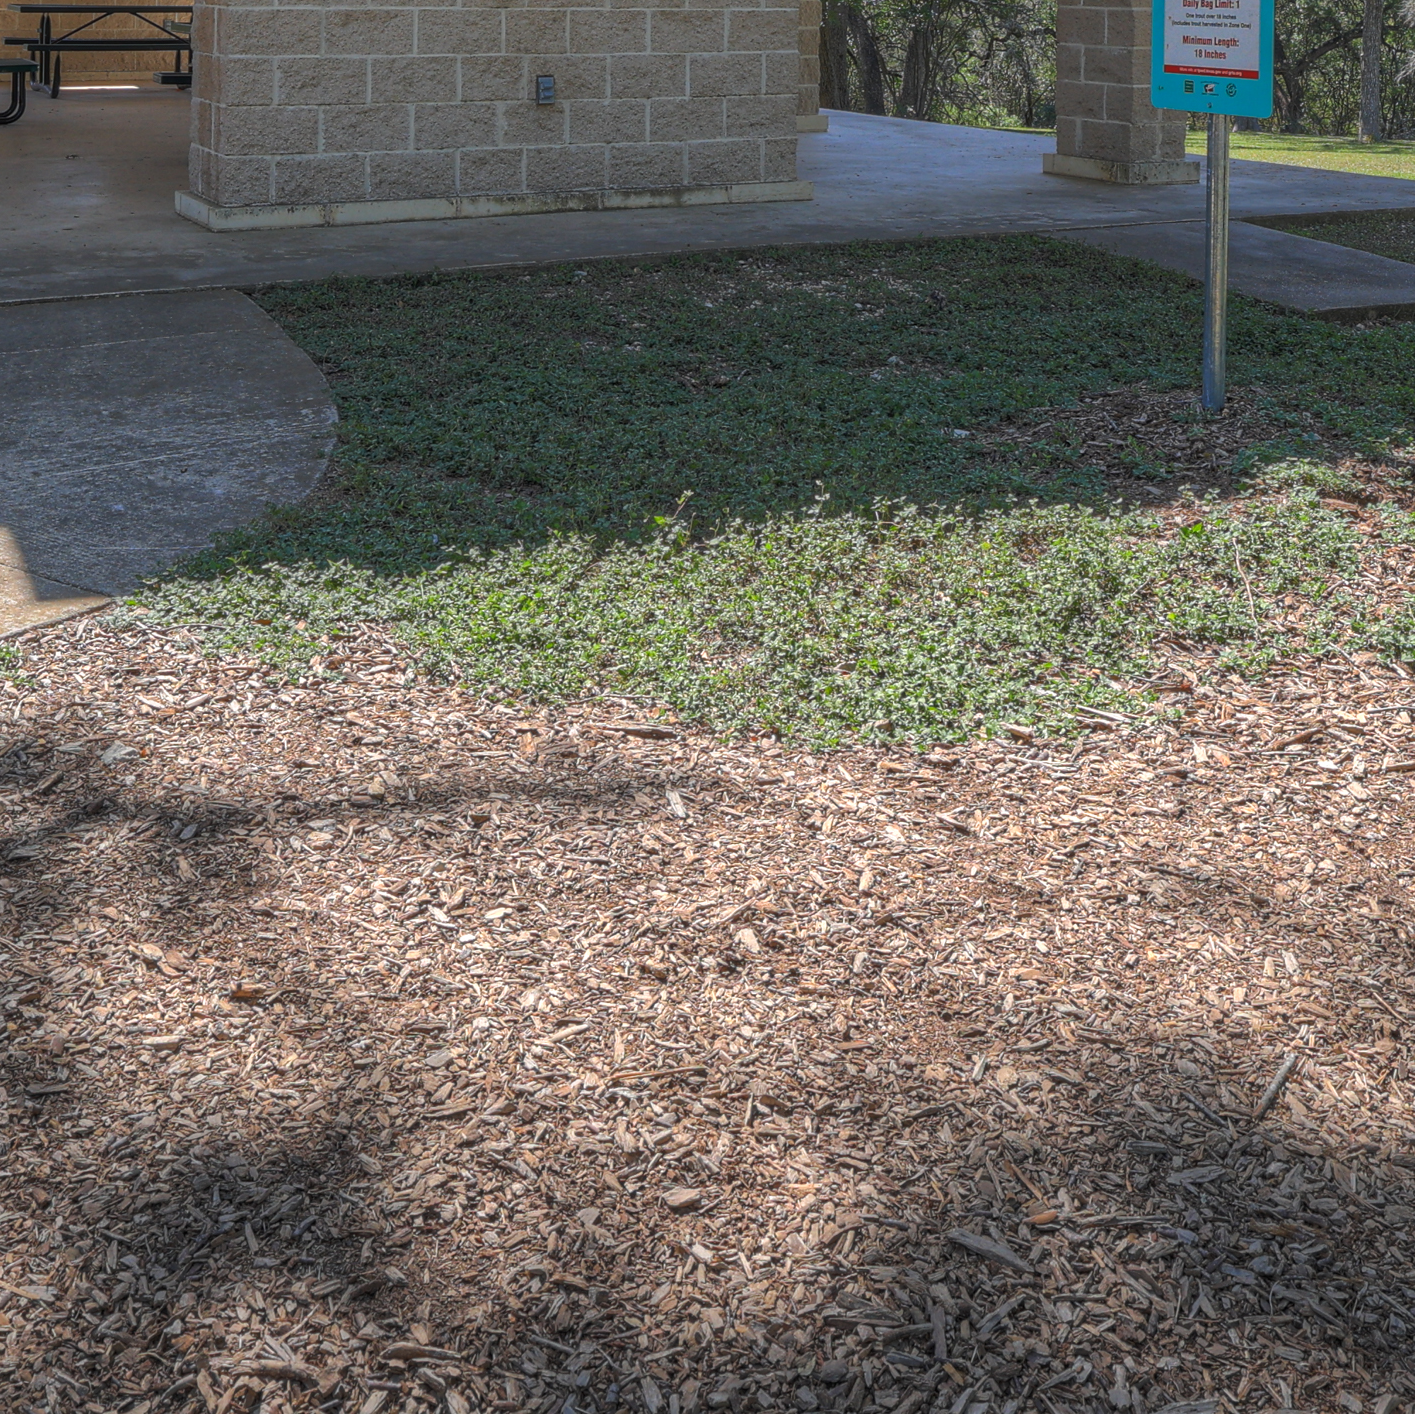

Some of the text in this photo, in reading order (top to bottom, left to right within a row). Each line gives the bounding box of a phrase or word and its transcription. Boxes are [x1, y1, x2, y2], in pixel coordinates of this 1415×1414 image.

[1183, 0, 1240, 9] Daily Bag Limit: 1
[1183, 35, 1239, 48] Minimum Length:
[1195, 49, 1226, 59] 18 Inches
